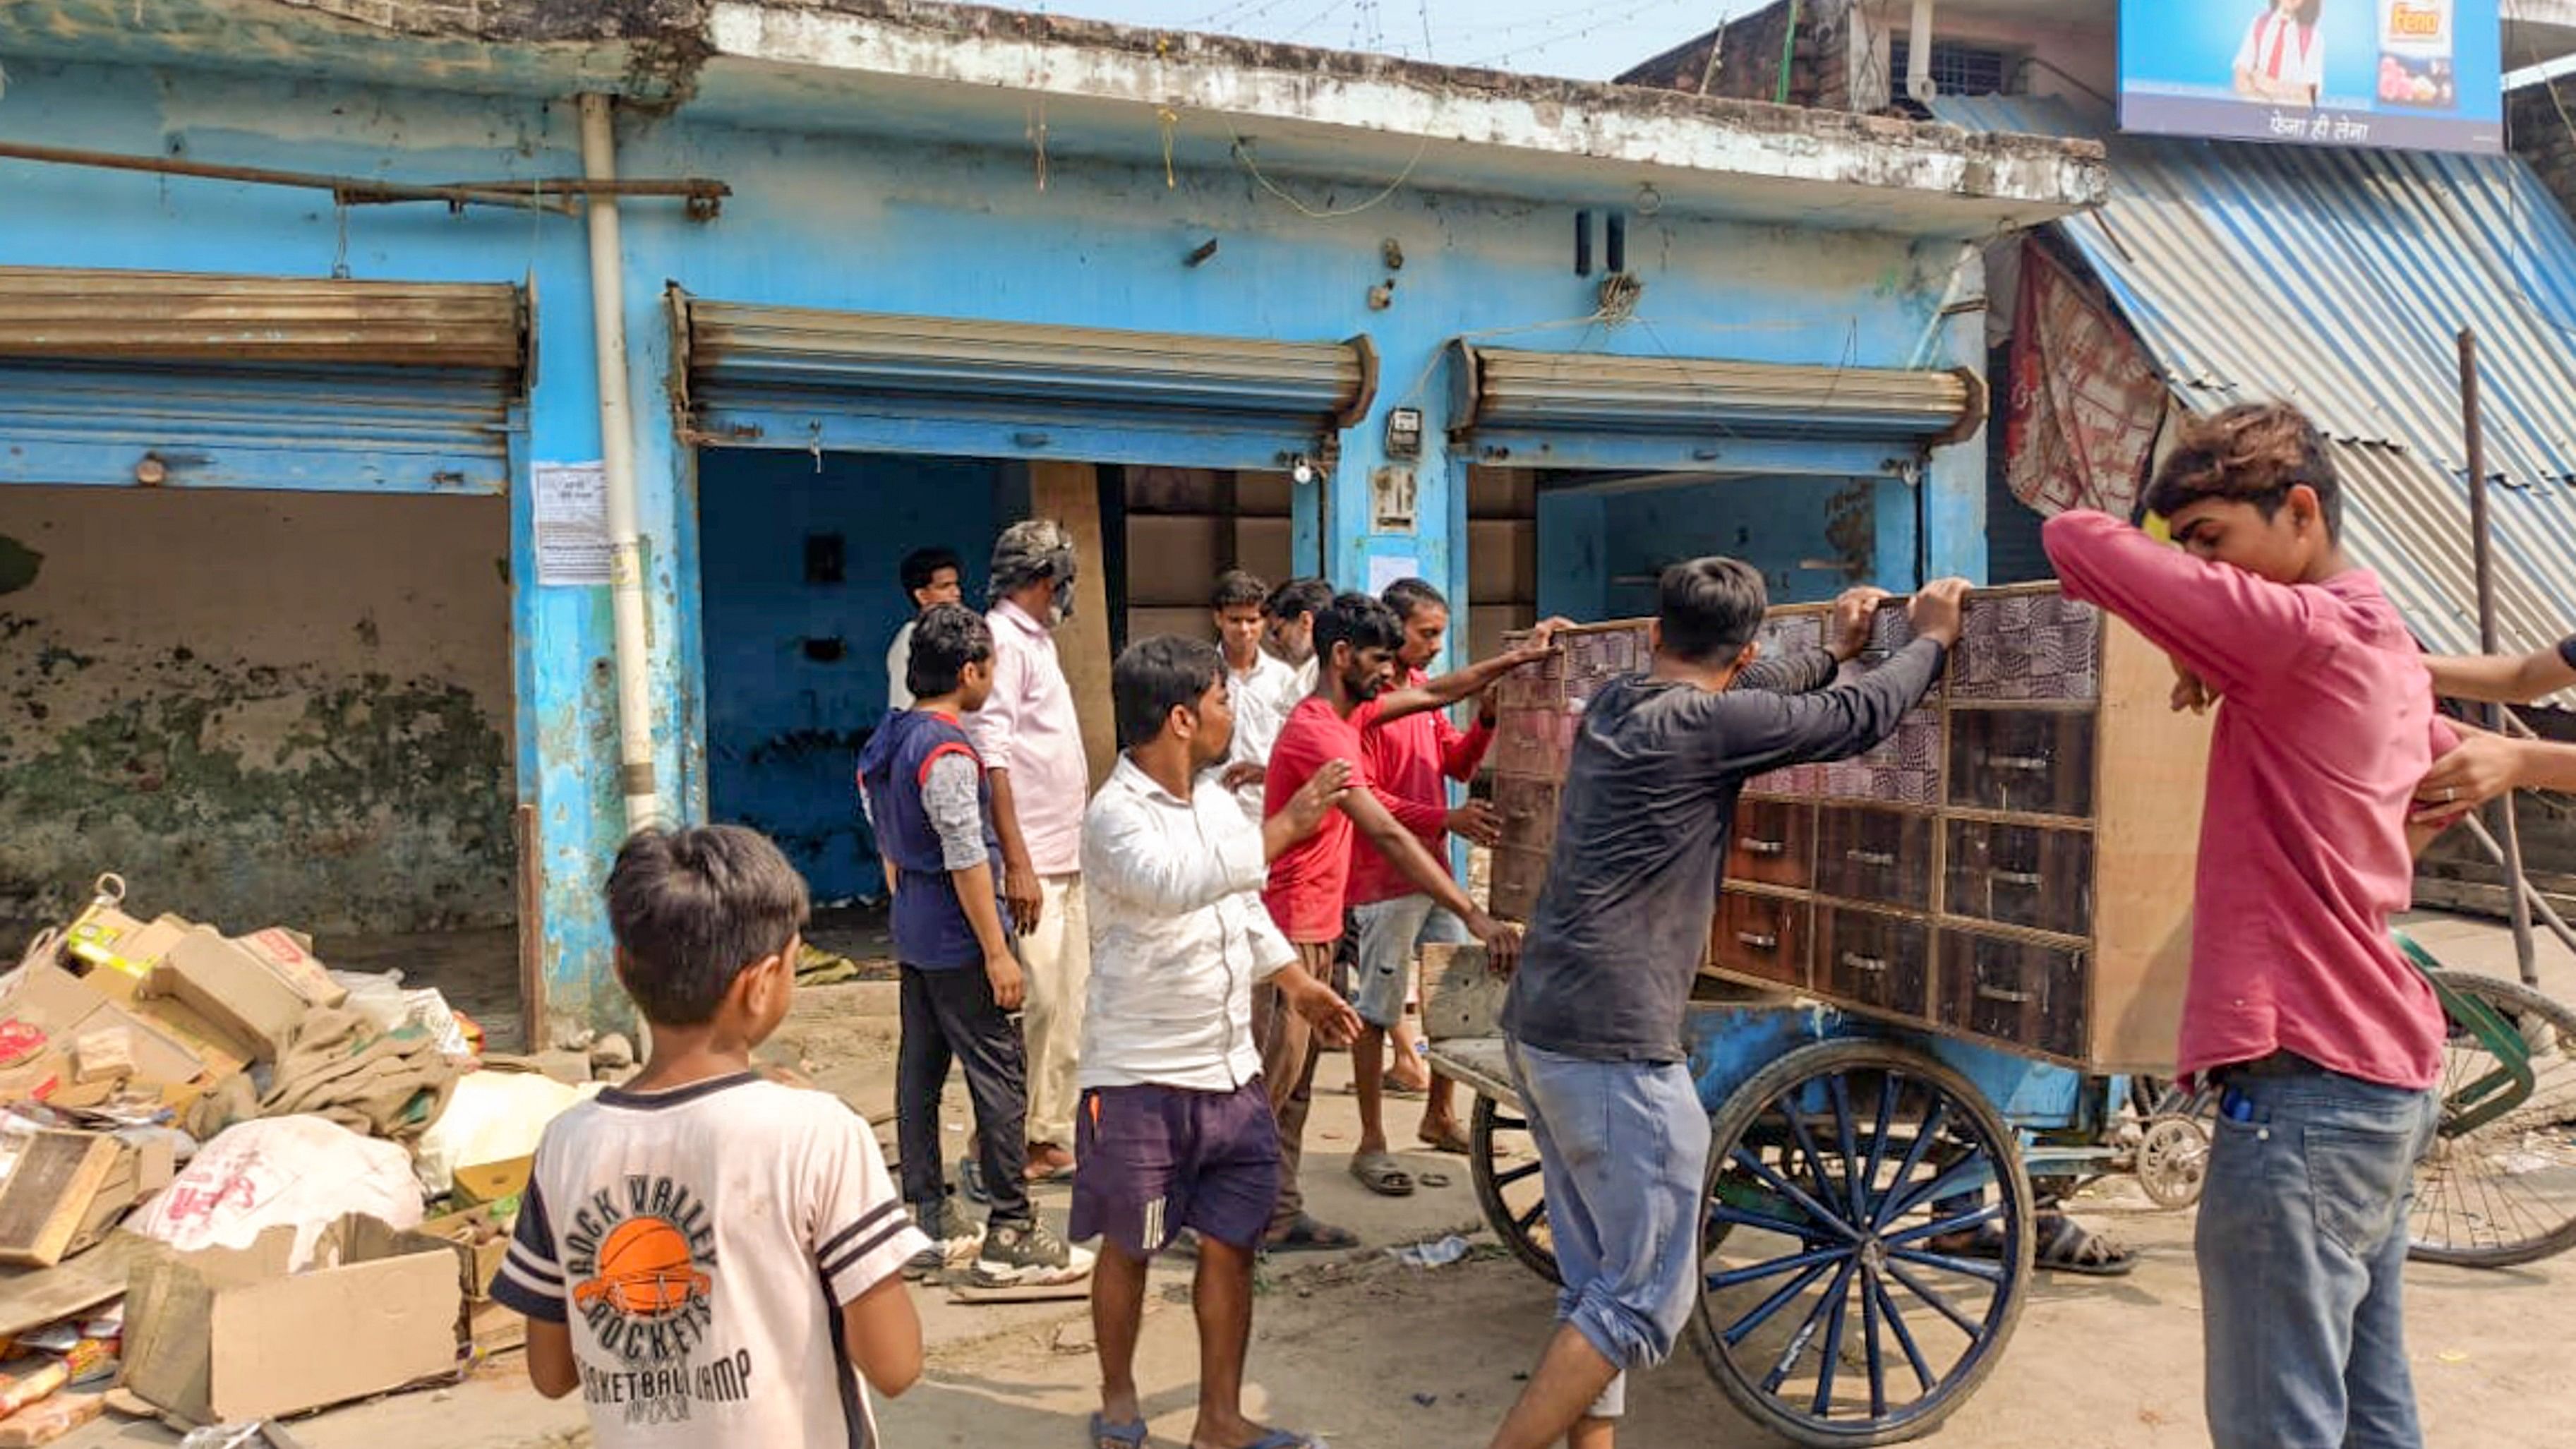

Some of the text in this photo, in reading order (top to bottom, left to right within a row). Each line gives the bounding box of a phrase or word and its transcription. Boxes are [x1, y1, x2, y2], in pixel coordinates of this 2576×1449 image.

[2270, 108, 2369, 142] फेना ही लेना
[566, 1174, 718, 1275] ROCK VALLEY
[586, 1294, 711, 1359] ROCKETS
